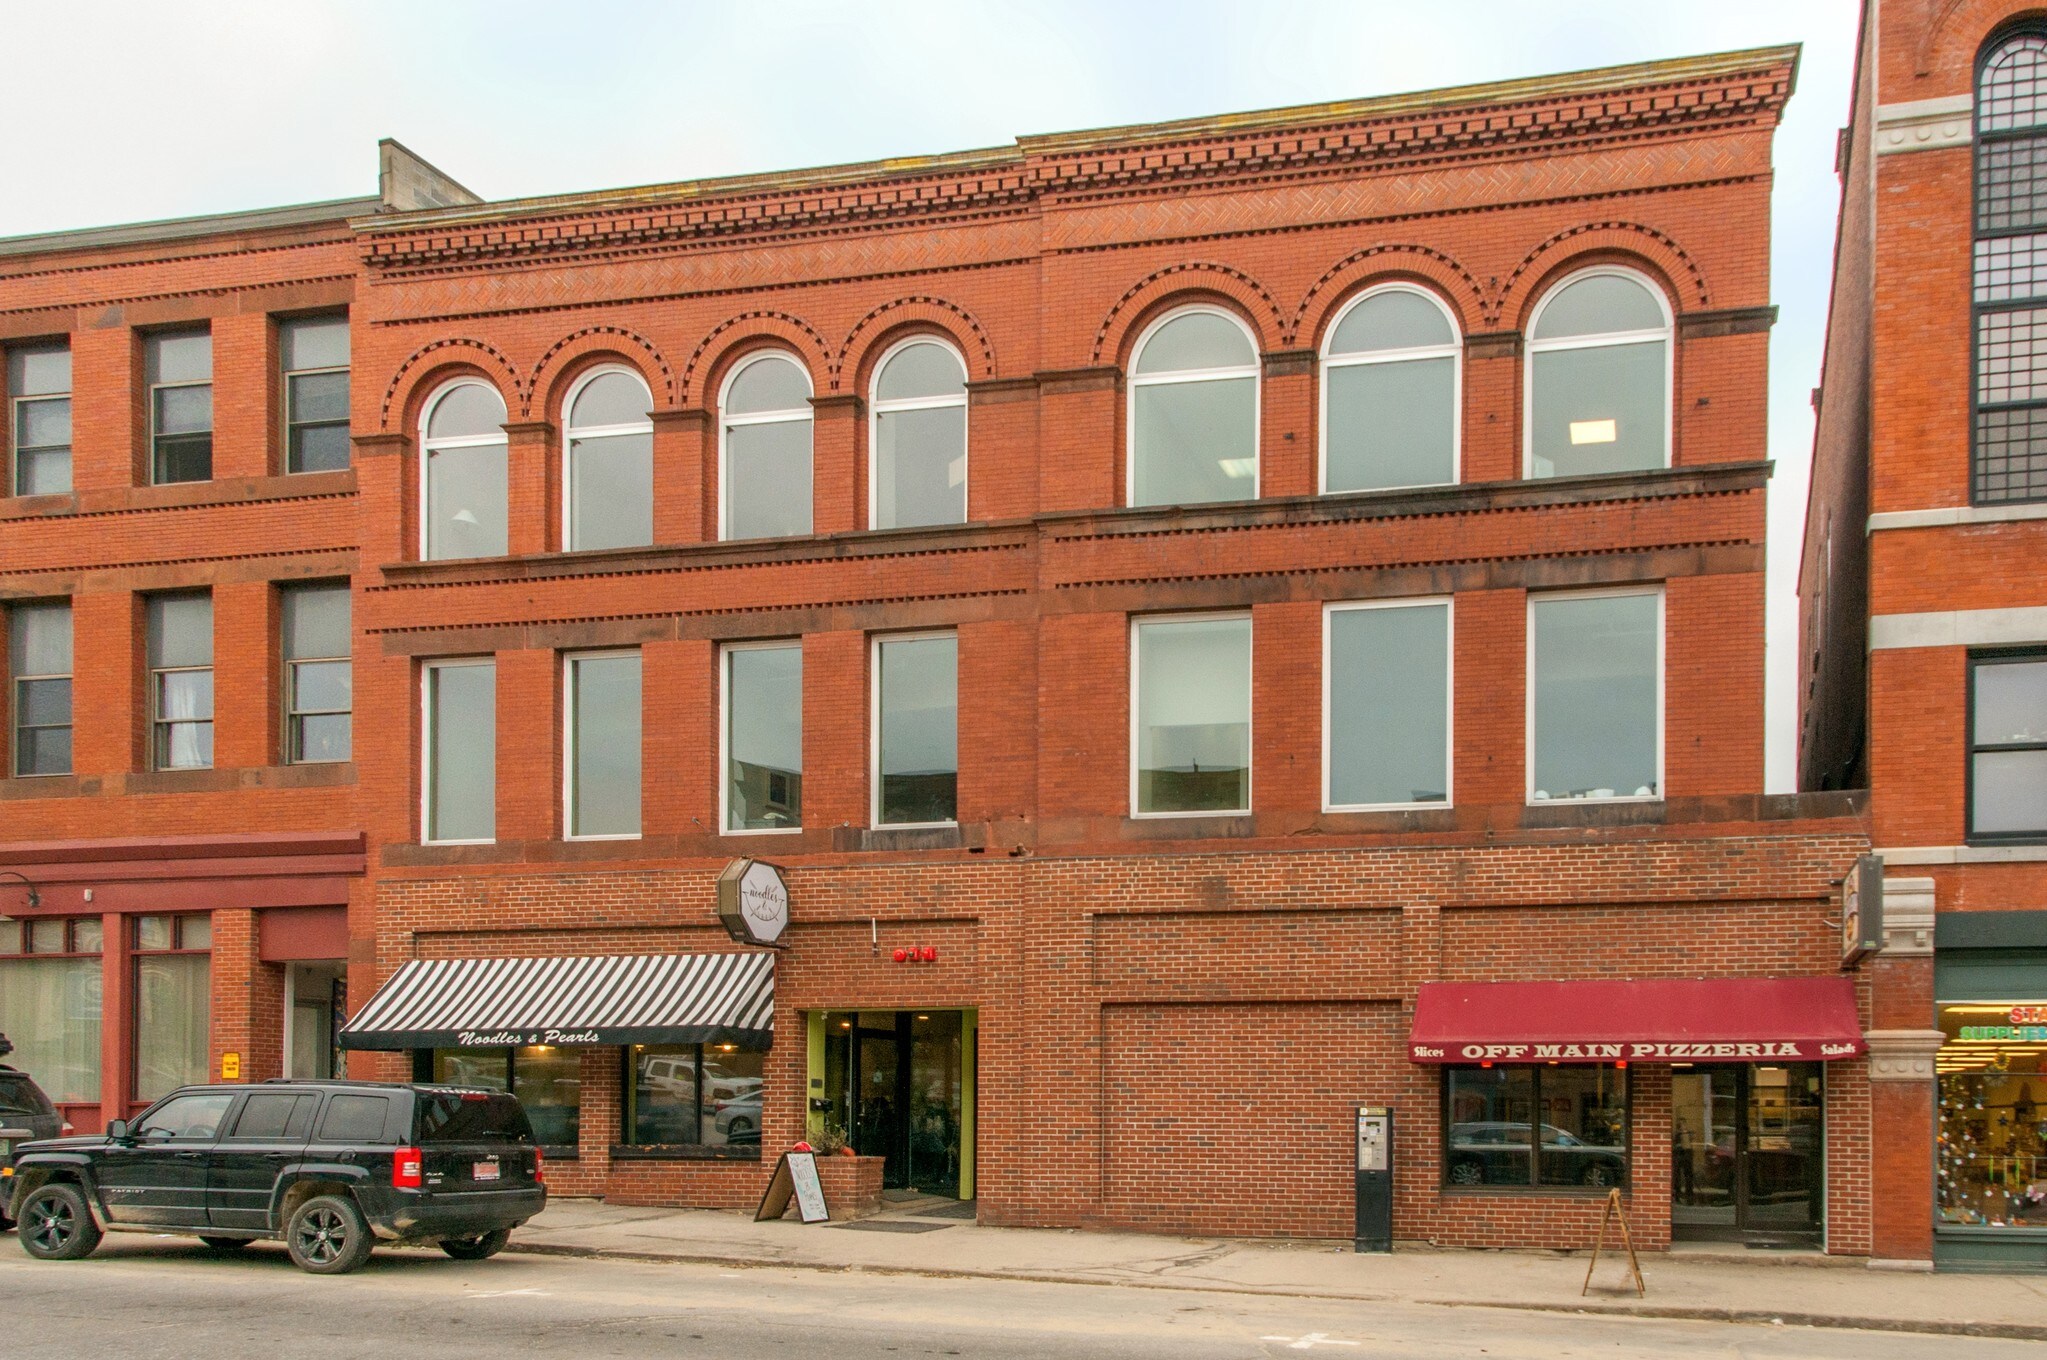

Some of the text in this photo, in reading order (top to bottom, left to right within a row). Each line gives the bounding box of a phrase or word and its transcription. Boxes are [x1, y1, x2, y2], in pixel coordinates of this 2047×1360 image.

[458, 1029, 600, 1045] Noodles & Pearls
[1960, 1026, 2047, 1040] SUPPLIES
[1414, 1046, 1444, 1057] Slices
[1462, 1043, 1802, 1058] OFF MAIN PIZZERIA
[1820, 1043, 1856, 1055] Salads
